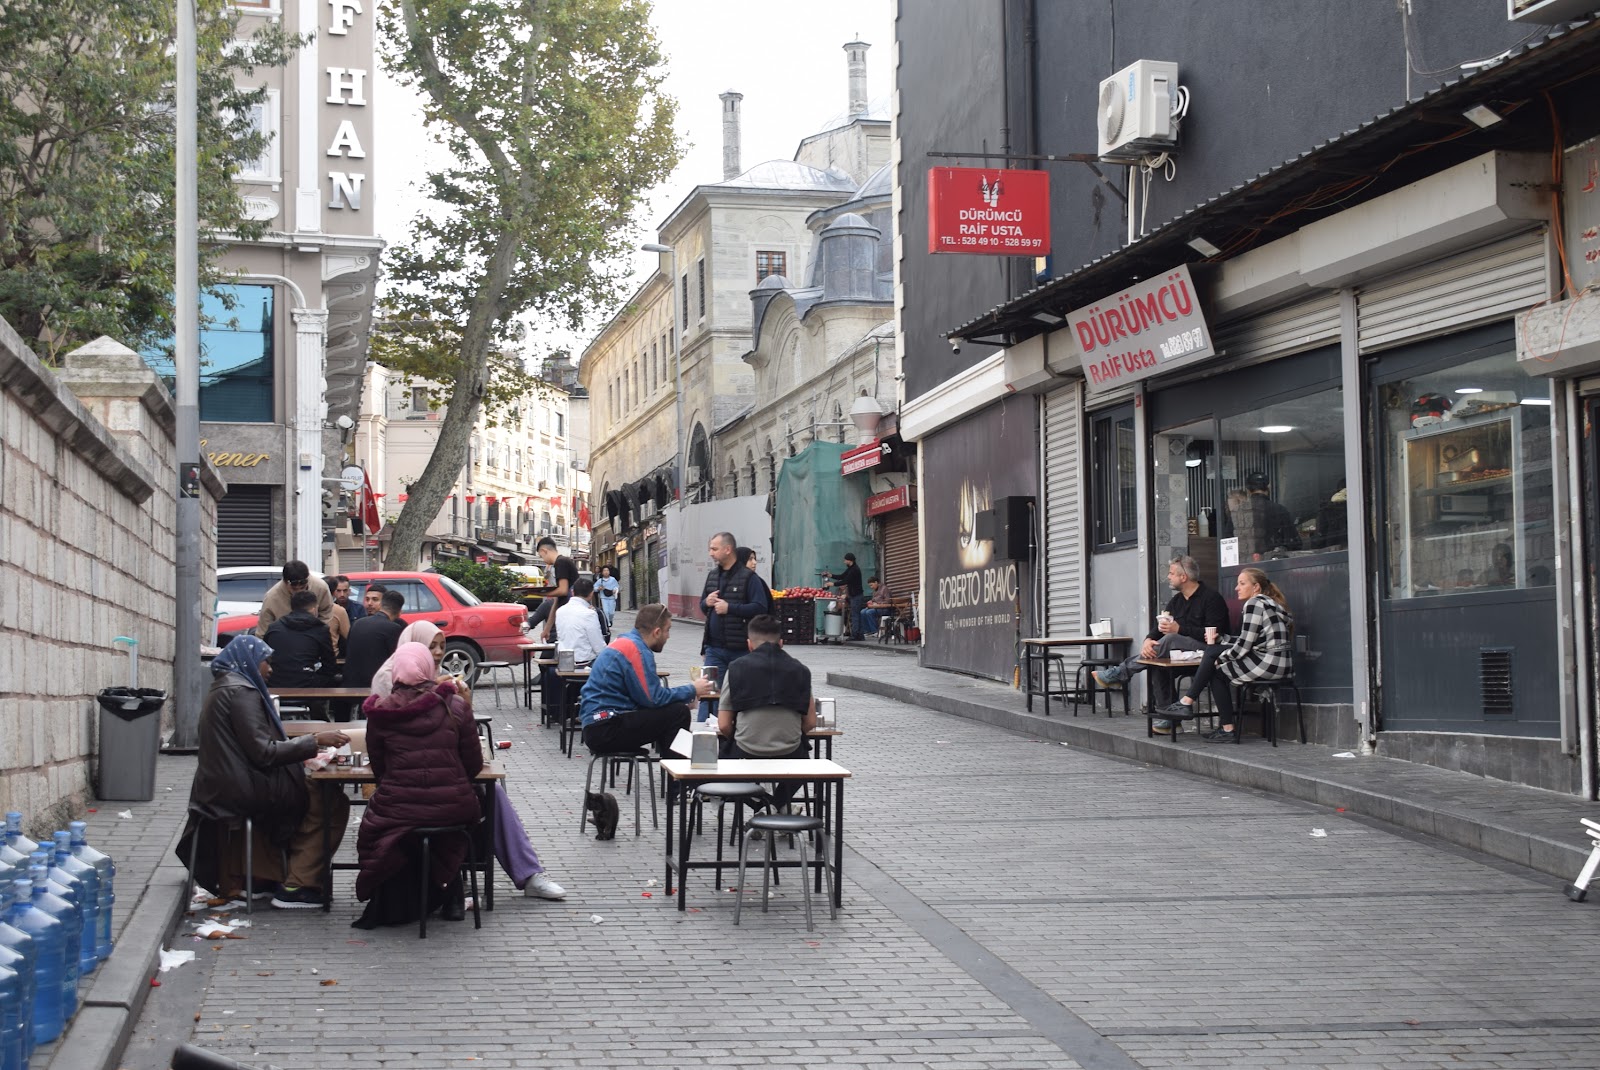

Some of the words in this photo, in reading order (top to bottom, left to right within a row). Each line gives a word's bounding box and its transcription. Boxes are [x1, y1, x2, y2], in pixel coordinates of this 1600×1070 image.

[326, 66, 368, 211] HAN
[960, 208, 1021, 221] DÜRÜMCÜ
[941, 236, 956, 245] TEL
[962, 236, 977, 246] 528
[978, 236, 988, 246] 49
[990, 238, 999, 246] 10
[1005, 238, 1019, 247] 528
[1021, 238, 1031, 247] 59
[1032, 239, 1041, 247] 97
[959, 222, 988, 235] RAİF
[991, 225, 1023, 236] USTA
[1076, 273, 1192, 352] DÜRÜMCÜ
[1089, 354, 1122, 385] RAİF
[1121, 348, 1157, 374] Usta
[940, 571, 980, 609] ROBERTO
[984, 564, 1017, 603] BRAVO
[959, 617, 976, 628] WONDER
[977, 616, 984, 626] OF
[984, 615, 993, 625] THE
[994, 614, 1010, 623] WORLD
